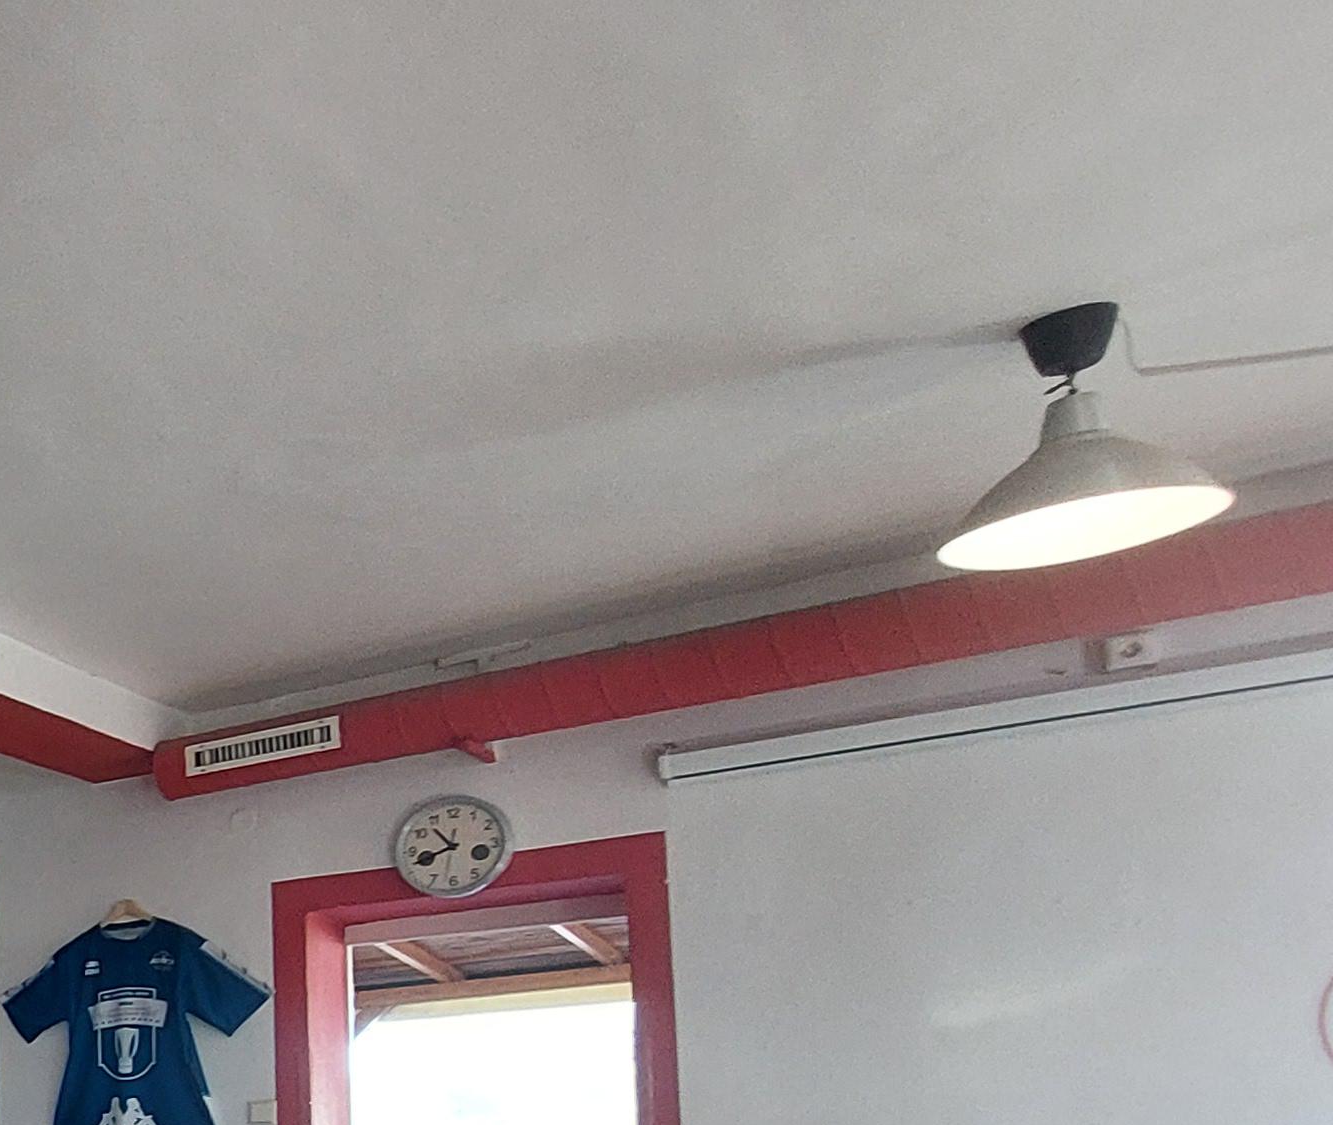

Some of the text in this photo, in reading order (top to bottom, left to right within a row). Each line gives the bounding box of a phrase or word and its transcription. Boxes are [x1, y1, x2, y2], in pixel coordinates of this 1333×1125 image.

[446, 807, 460, 818] 12
[483, 819, 493, 831] 2
[414, 828, 428, 839] 10
[490, 837, 500, 848] 3
[408, 846, 417, 857] 9
[469, 868, 480, 879] 5
[428, 873, 439, 889] 7
[448, 876, 459, 886] 6
